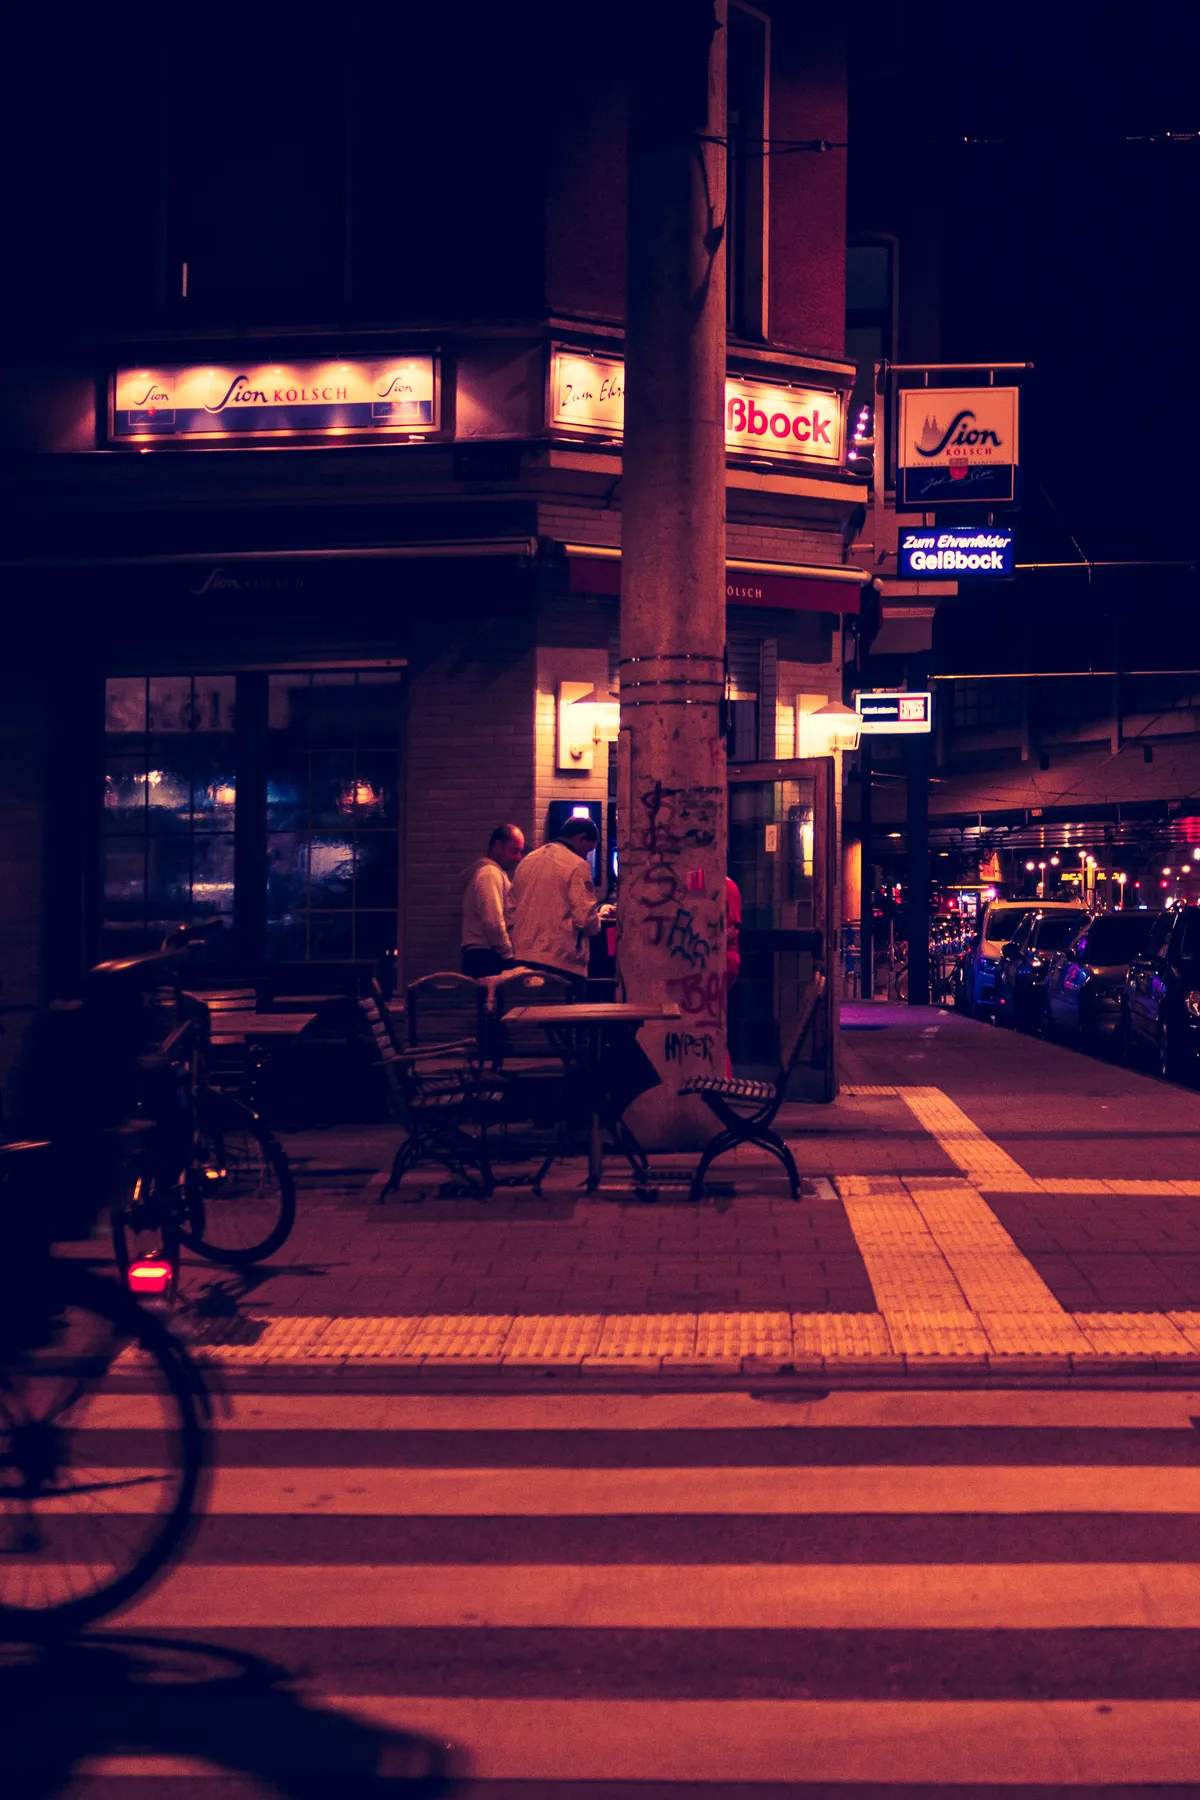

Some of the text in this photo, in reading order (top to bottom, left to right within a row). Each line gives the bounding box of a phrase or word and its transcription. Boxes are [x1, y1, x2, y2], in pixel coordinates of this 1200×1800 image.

[134, 385, 169, 405] Sion
[203, 375, 348, 413] Sion KÖLSCH
[376, 377, 413, 398] Sion
[561, 377, 625, 407] Zum Ehr
[914, 410, 1002, 457] Sion
[945, 447, 993, 457] KÖLSCH
[902, 534, 1012, 549] Zum Ehrenfelder
[910, 550, 1004, 570] Geißbock
